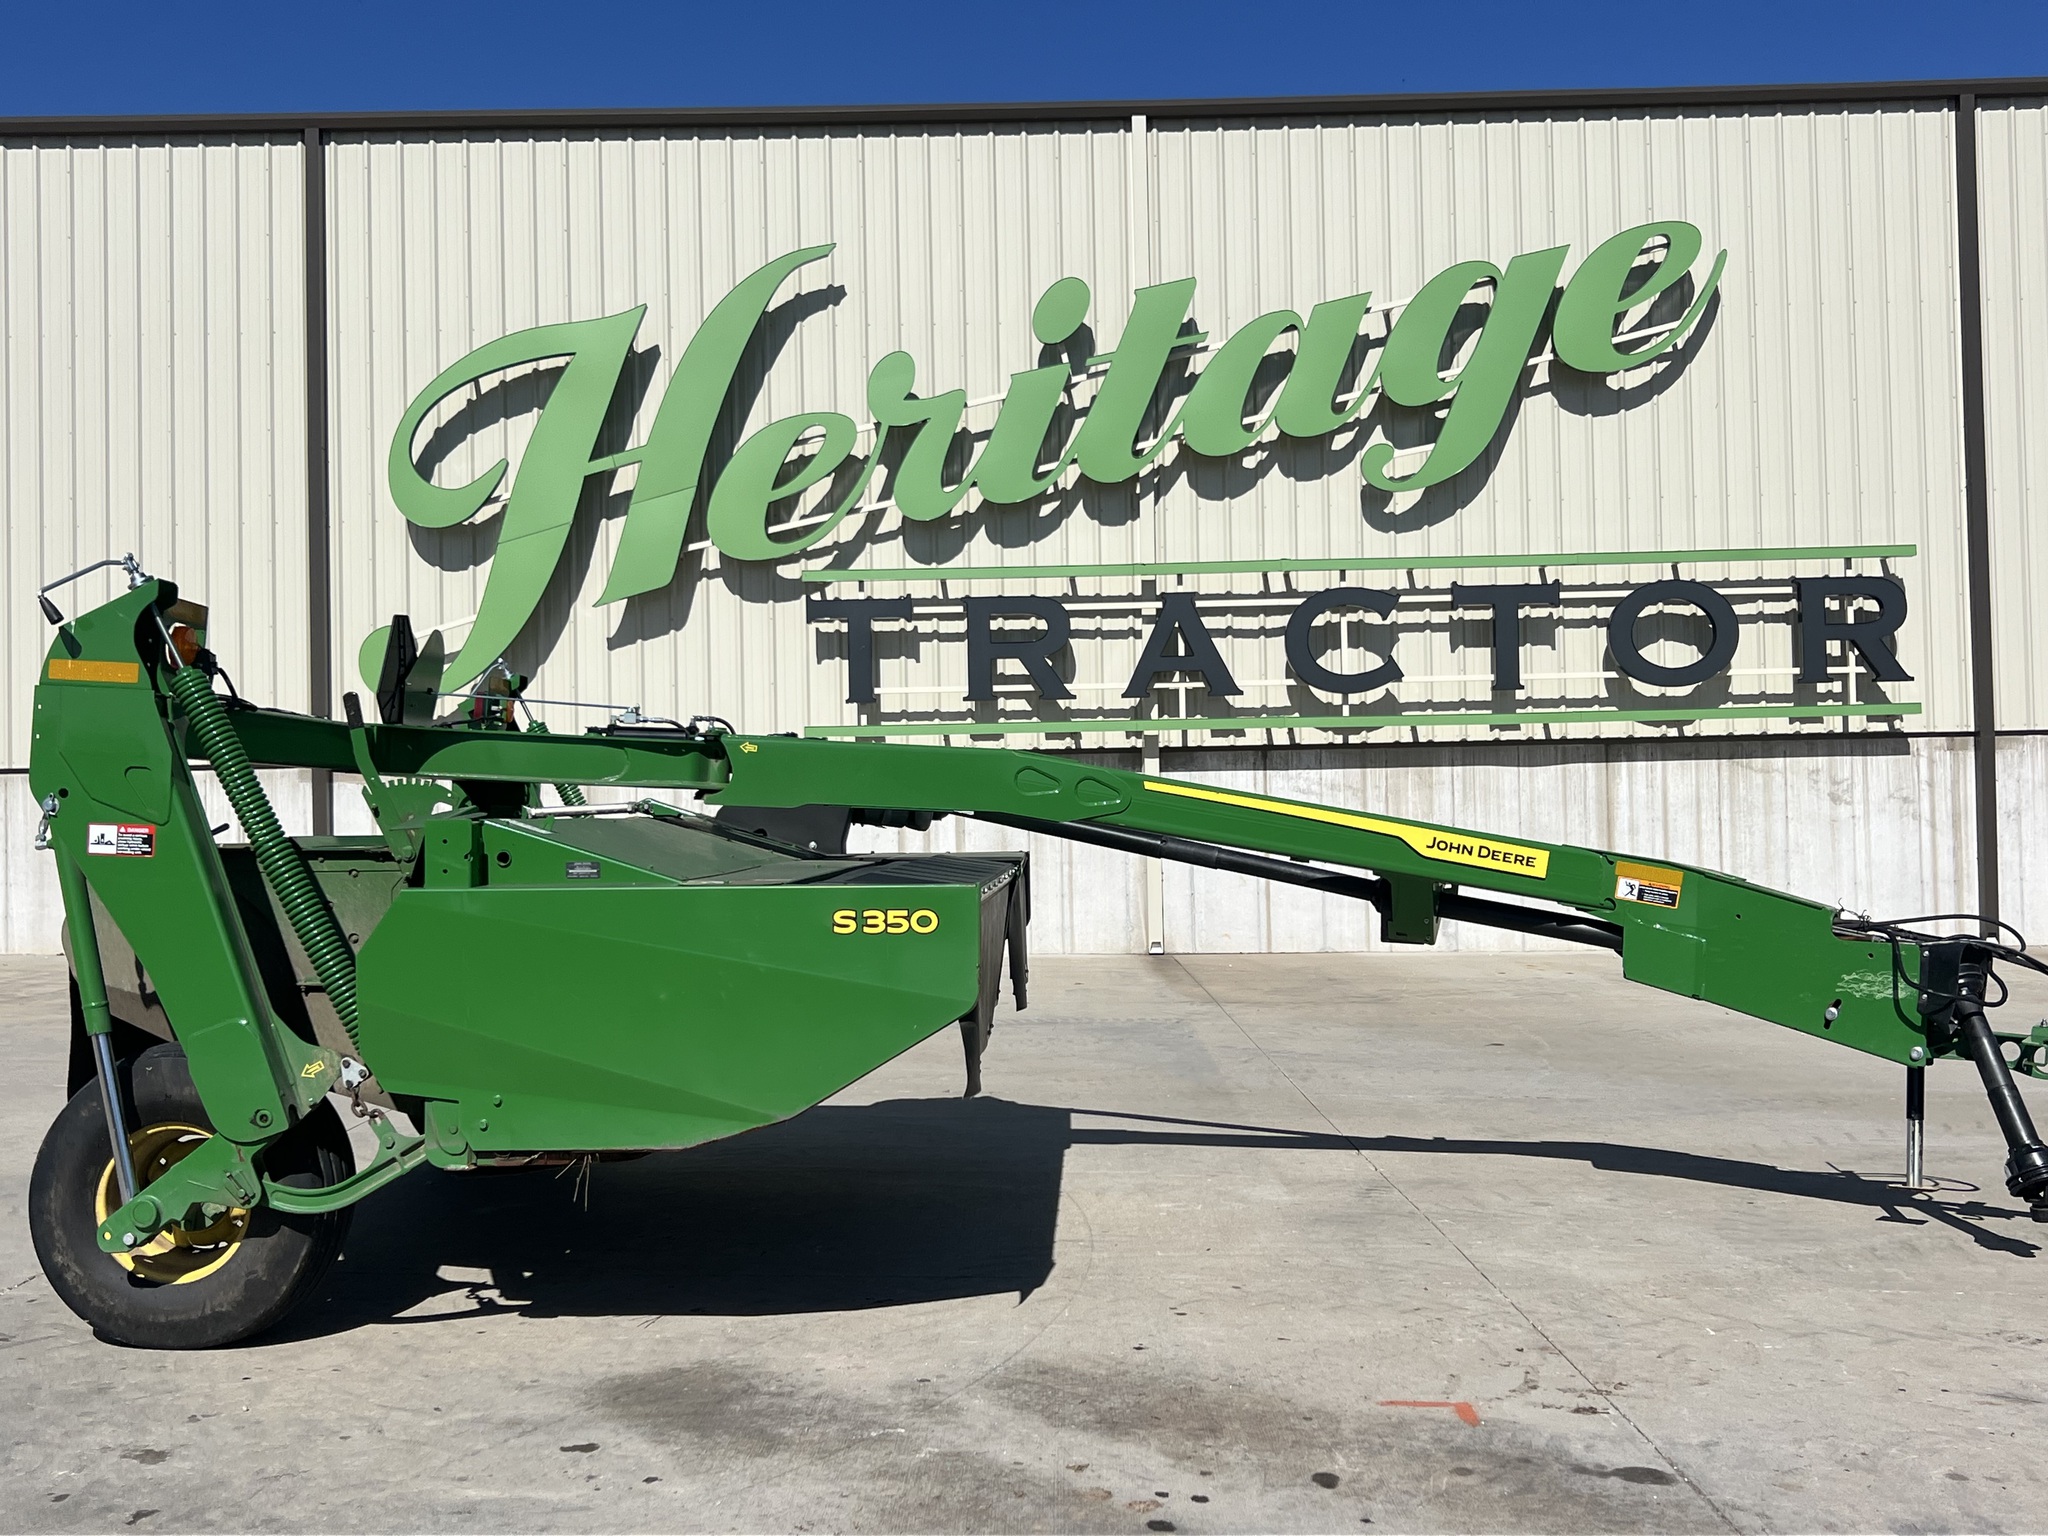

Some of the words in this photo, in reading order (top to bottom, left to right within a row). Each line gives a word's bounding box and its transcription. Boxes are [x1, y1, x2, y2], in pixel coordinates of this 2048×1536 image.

[359, 221, 1727, 694] Heritage
[806, 575, 1914, 703] TRACTOR
[1426, 836, 1474, 857] JOHN
[1477, 845, 1537, 868] DEERE
